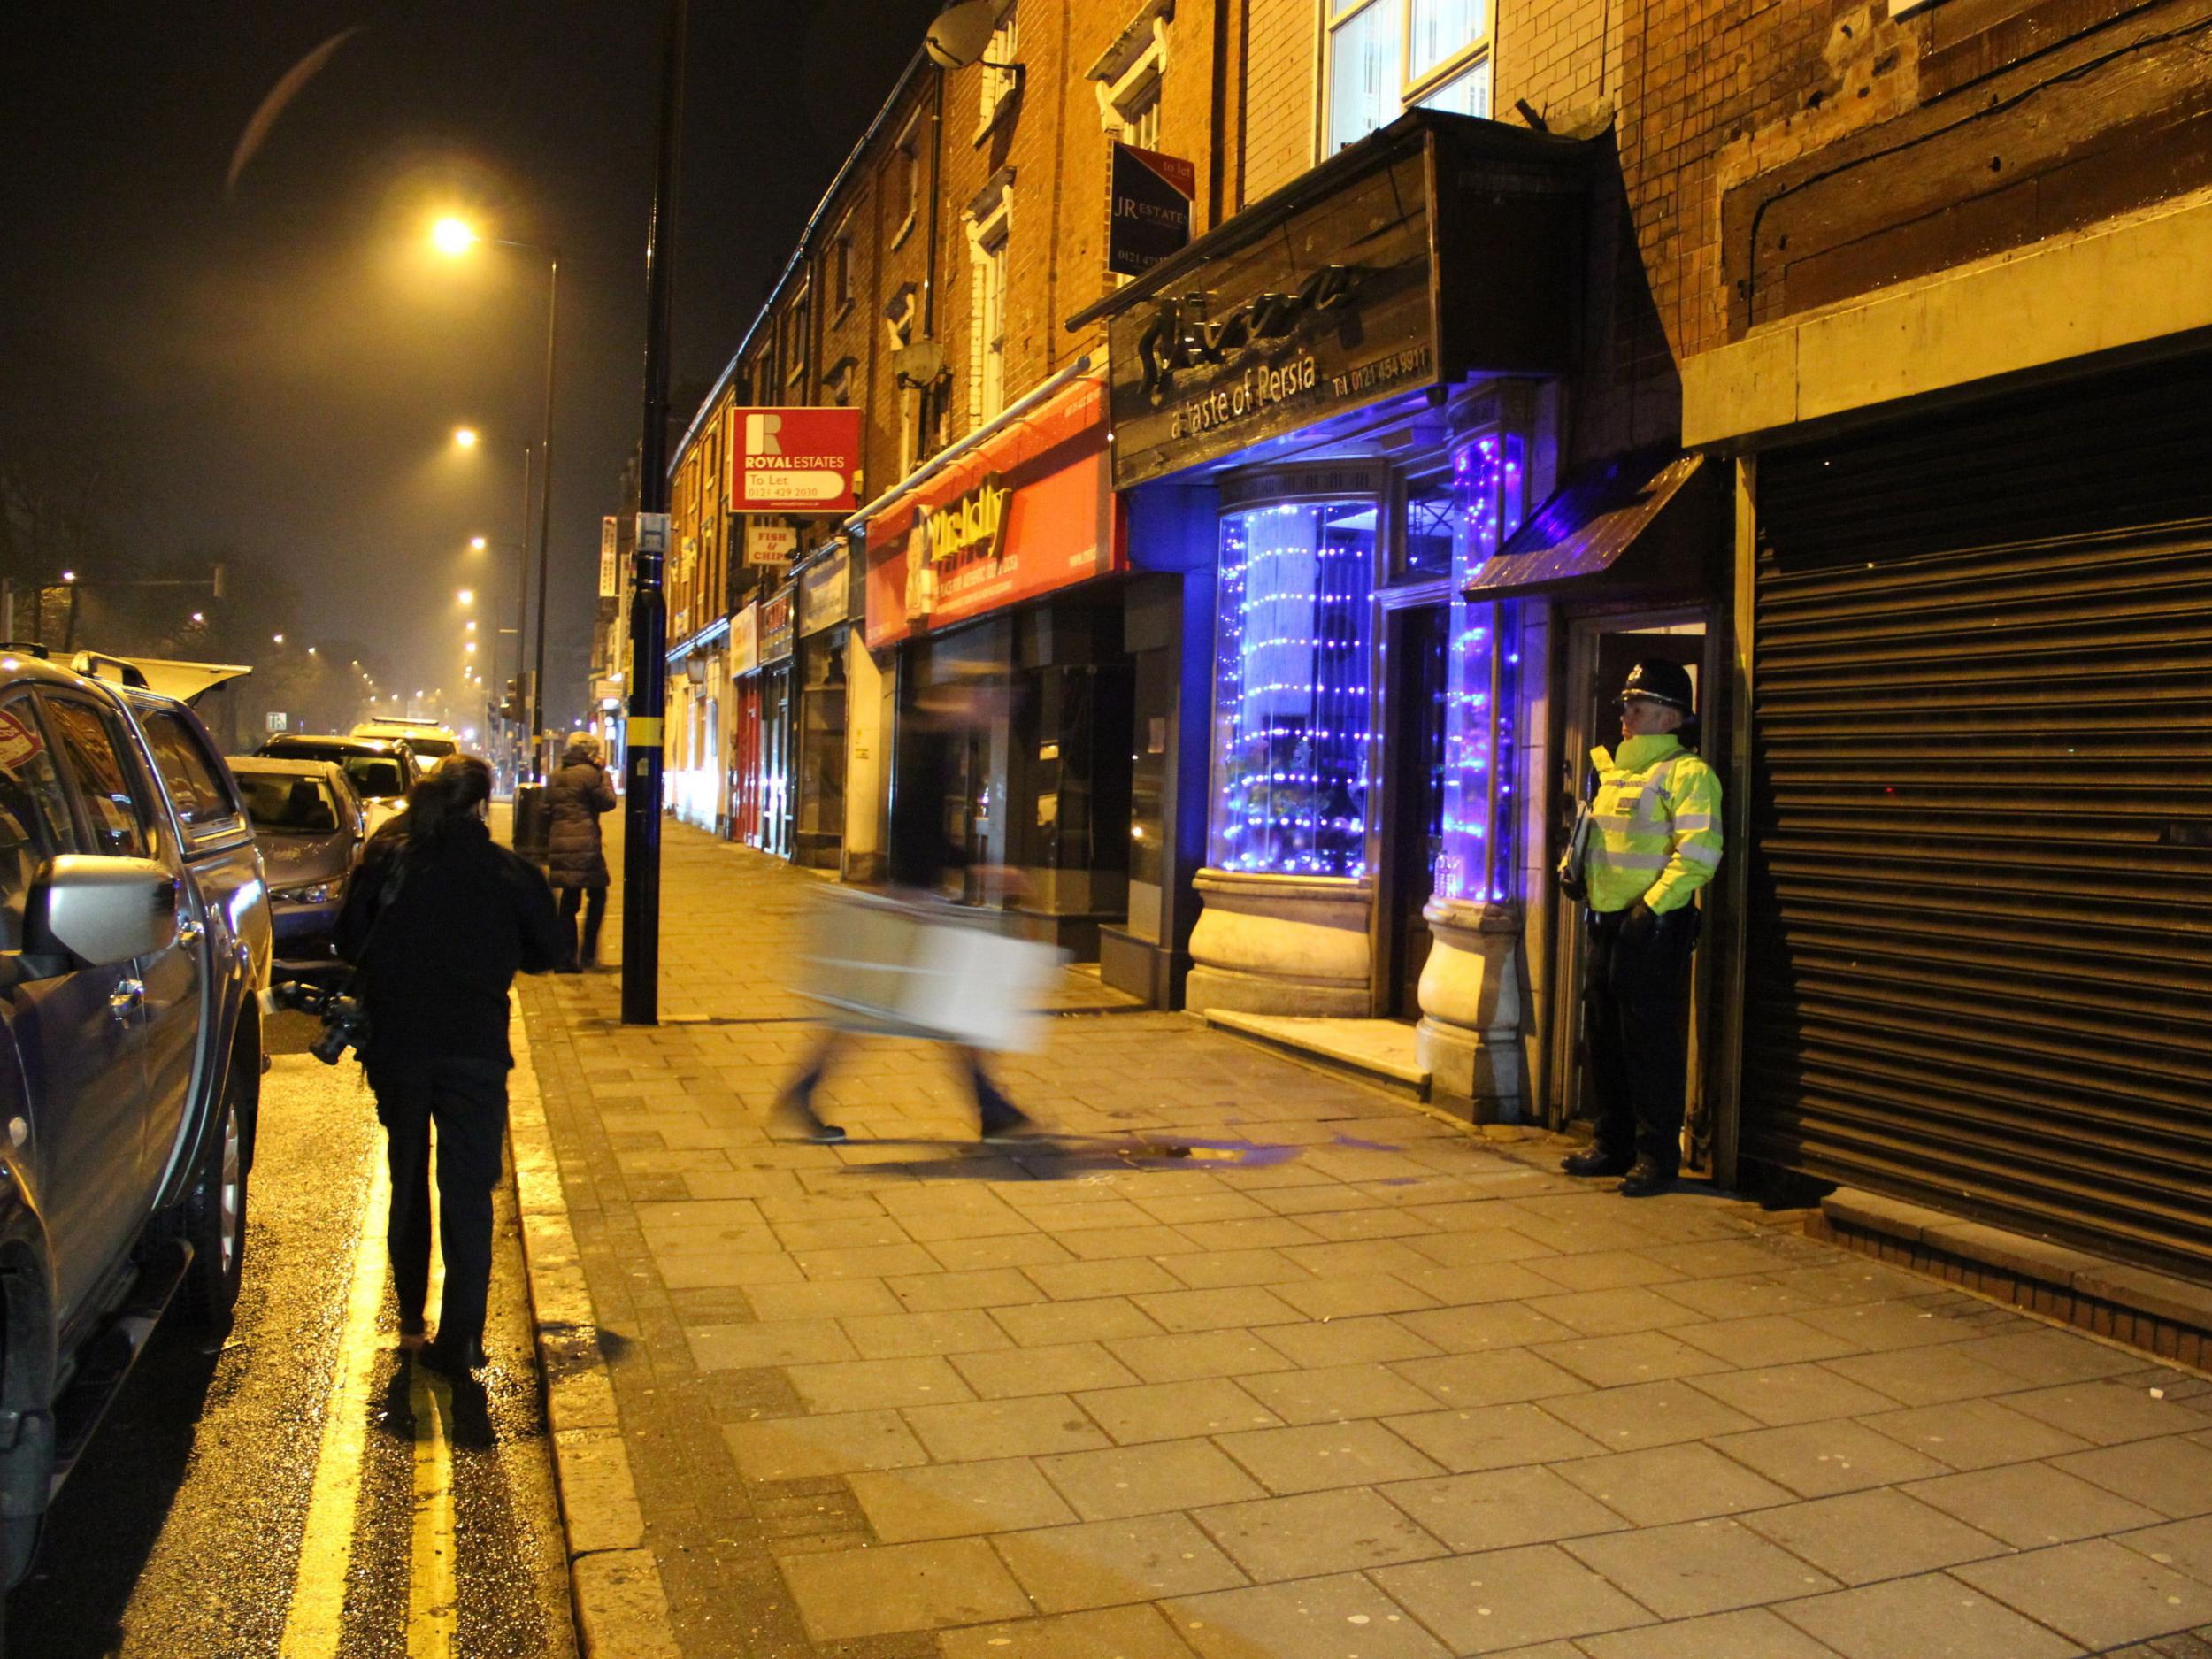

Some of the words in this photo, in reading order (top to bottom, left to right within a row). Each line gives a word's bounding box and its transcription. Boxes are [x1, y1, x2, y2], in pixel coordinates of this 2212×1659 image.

[1114, 196, 1139, 219] JR
[1350, 364, 1375, 391] 0121
[1171, 411, 1182, 439] a
[1187, 390, 1230, 435] taste
[1233, 368, 1252, 416] of
[1257, 347, 1316, 407] Persia
[750, 474, 764, 486] To
[769, 474, 788, 485] Let
[757, 532, 787, 541] FISH
[753, 551, 787, 560] CHIP
